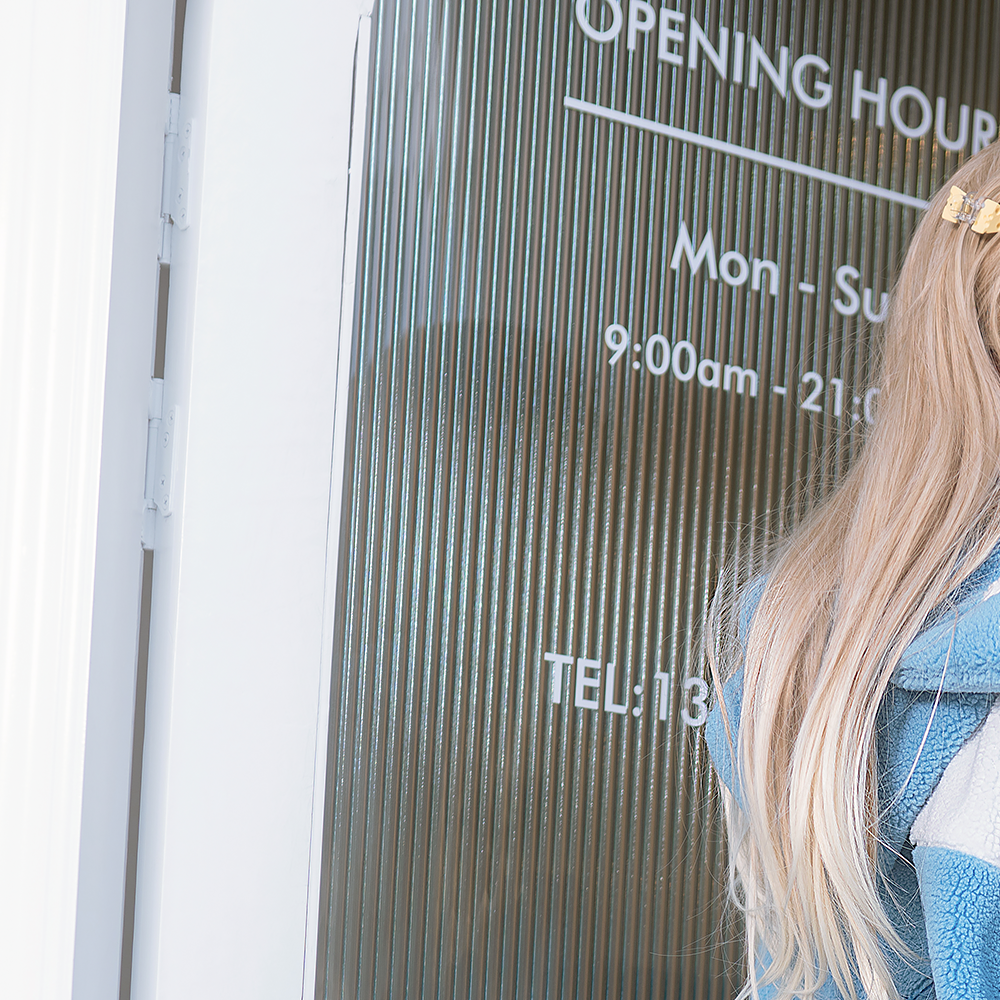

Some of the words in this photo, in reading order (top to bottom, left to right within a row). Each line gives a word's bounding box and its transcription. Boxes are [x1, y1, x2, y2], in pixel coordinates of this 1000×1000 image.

[575, 0, 833, 110] OPENING
[669, 220, 780, 296] Mon
[833, 265, 889, 323] Su
[603, 323, 759, 398] 9:00am
[543, 651, 709, 727] TEL:13
